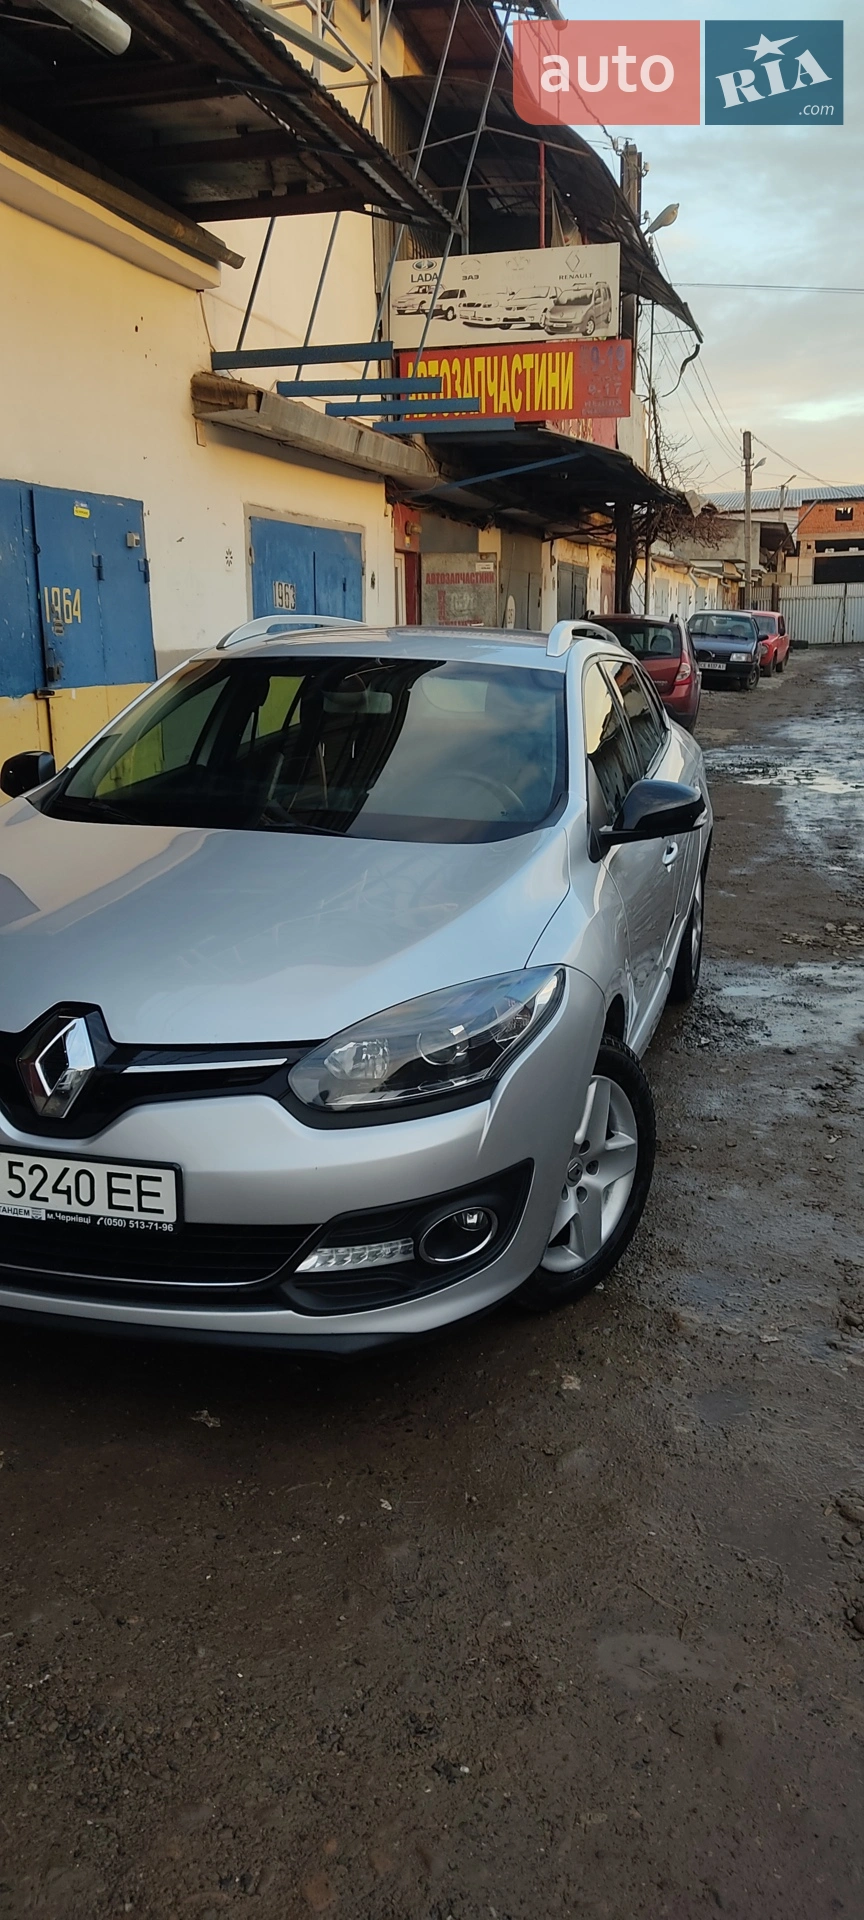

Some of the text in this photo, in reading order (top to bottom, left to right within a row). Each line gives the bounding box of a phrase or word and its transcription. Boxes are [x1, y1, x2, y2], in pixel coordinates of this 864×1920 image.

[411, 272, 440, 283] LADA
[558, 272, 594, 281] RENAULT
[425, 572, 495, 585] АВТОЗАПЧАСТИНИ
[44, 586, 82, 624] 1964
[273, 581, 296, 610] 1963
[7, 1160, 165, 1215] 5240 EE
[46, 1212, 92, 1224] м.Чернівці
[103, 1217, 127, 1228] (050)
[128, 1220, 174, 1232] 513-71-96
